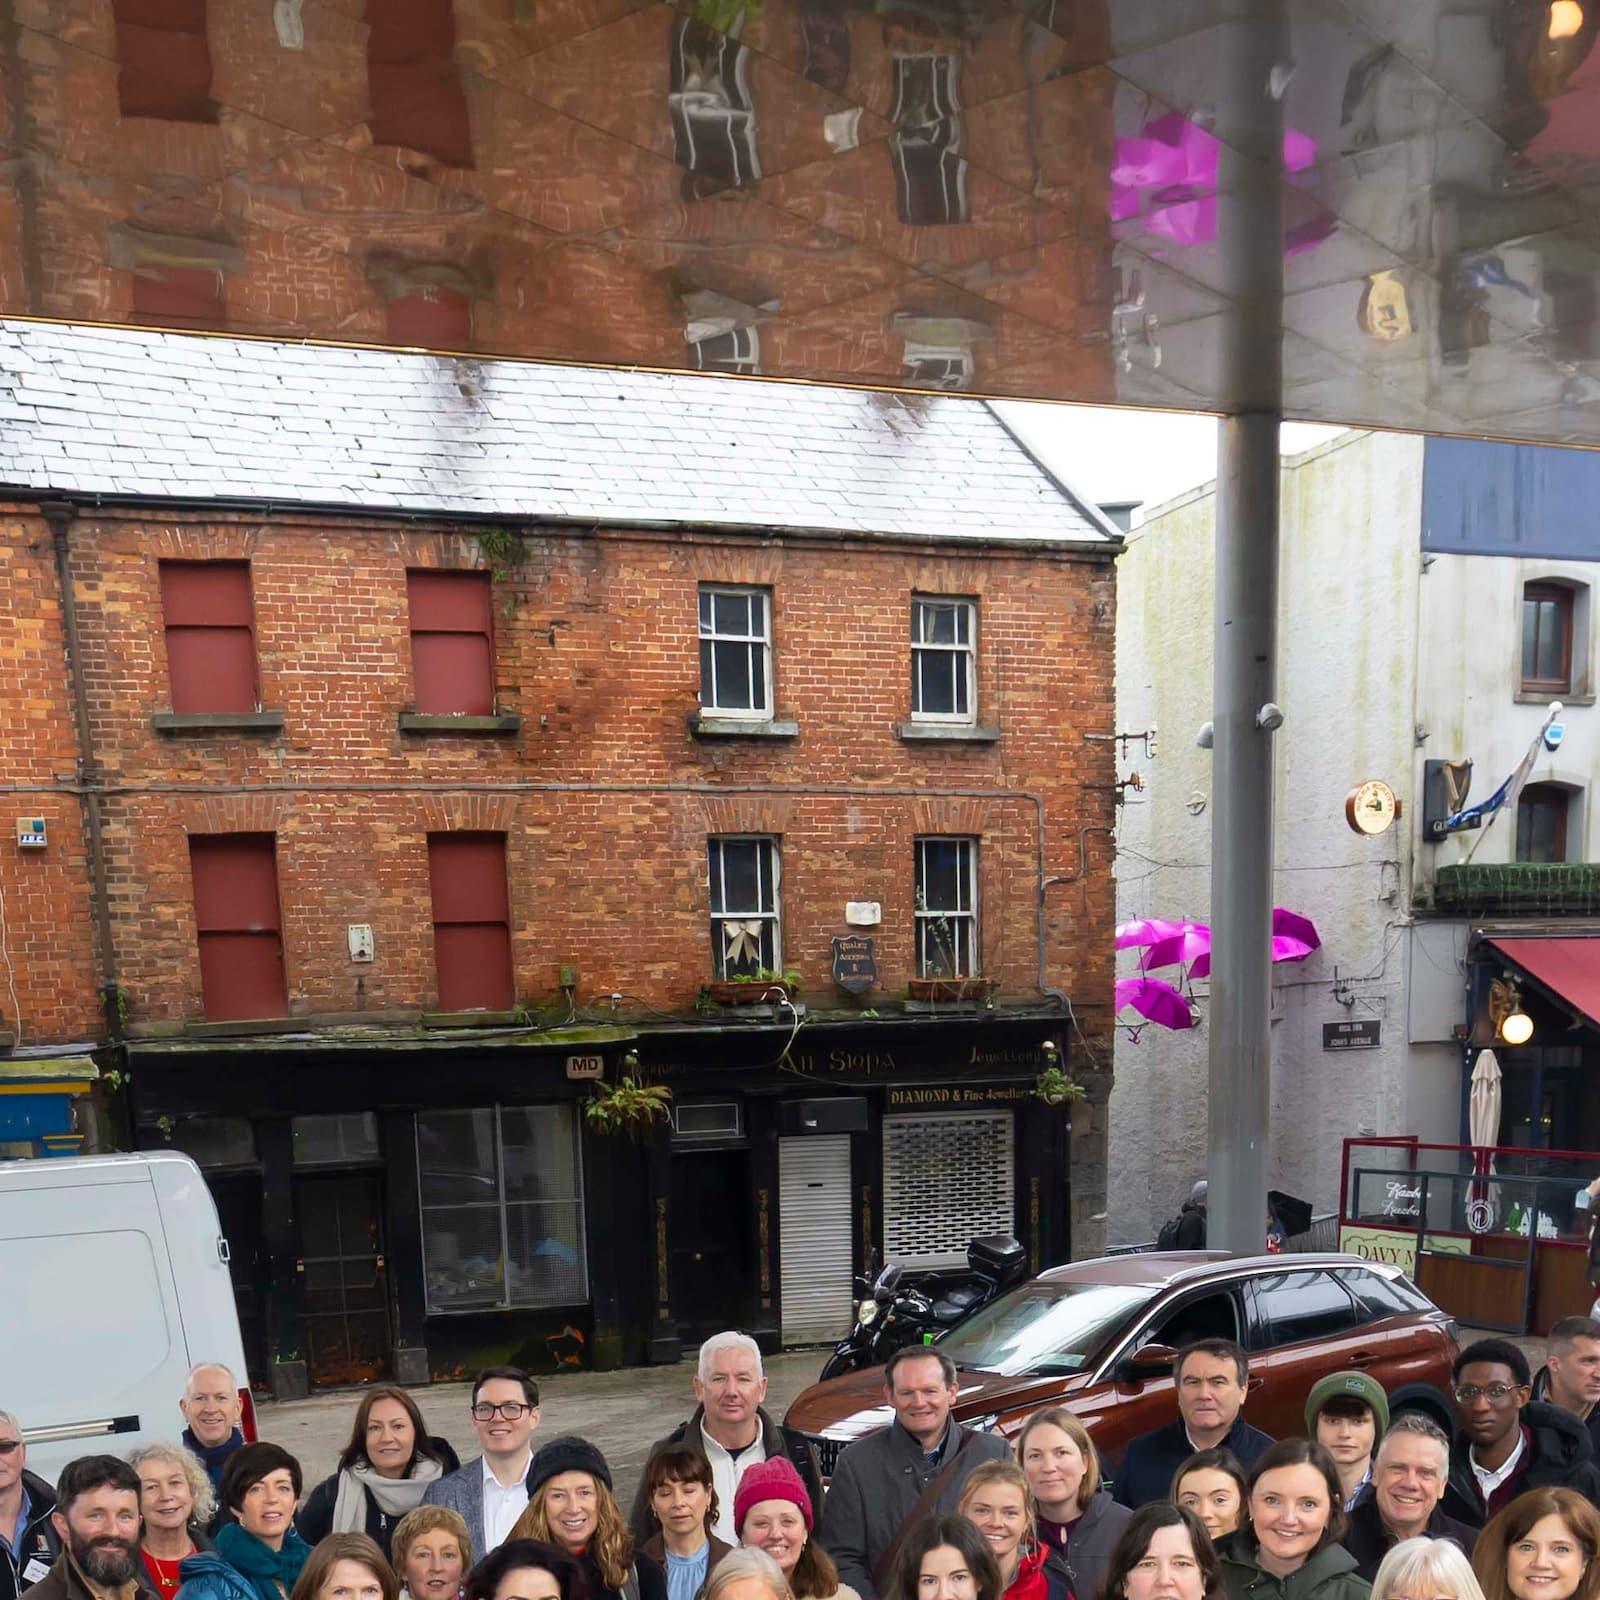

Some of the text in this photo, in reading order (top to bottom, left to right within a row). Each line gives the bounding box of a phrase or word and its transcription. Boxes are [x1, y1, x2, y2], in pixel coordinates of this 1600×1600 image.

[572, 1058, 598, 1071] MD
[891, 1089, 950, 1104] DIAMOND
[952, 1089, 961, 1101] &
[1357, 1244, 1402, 1263] DAVY
